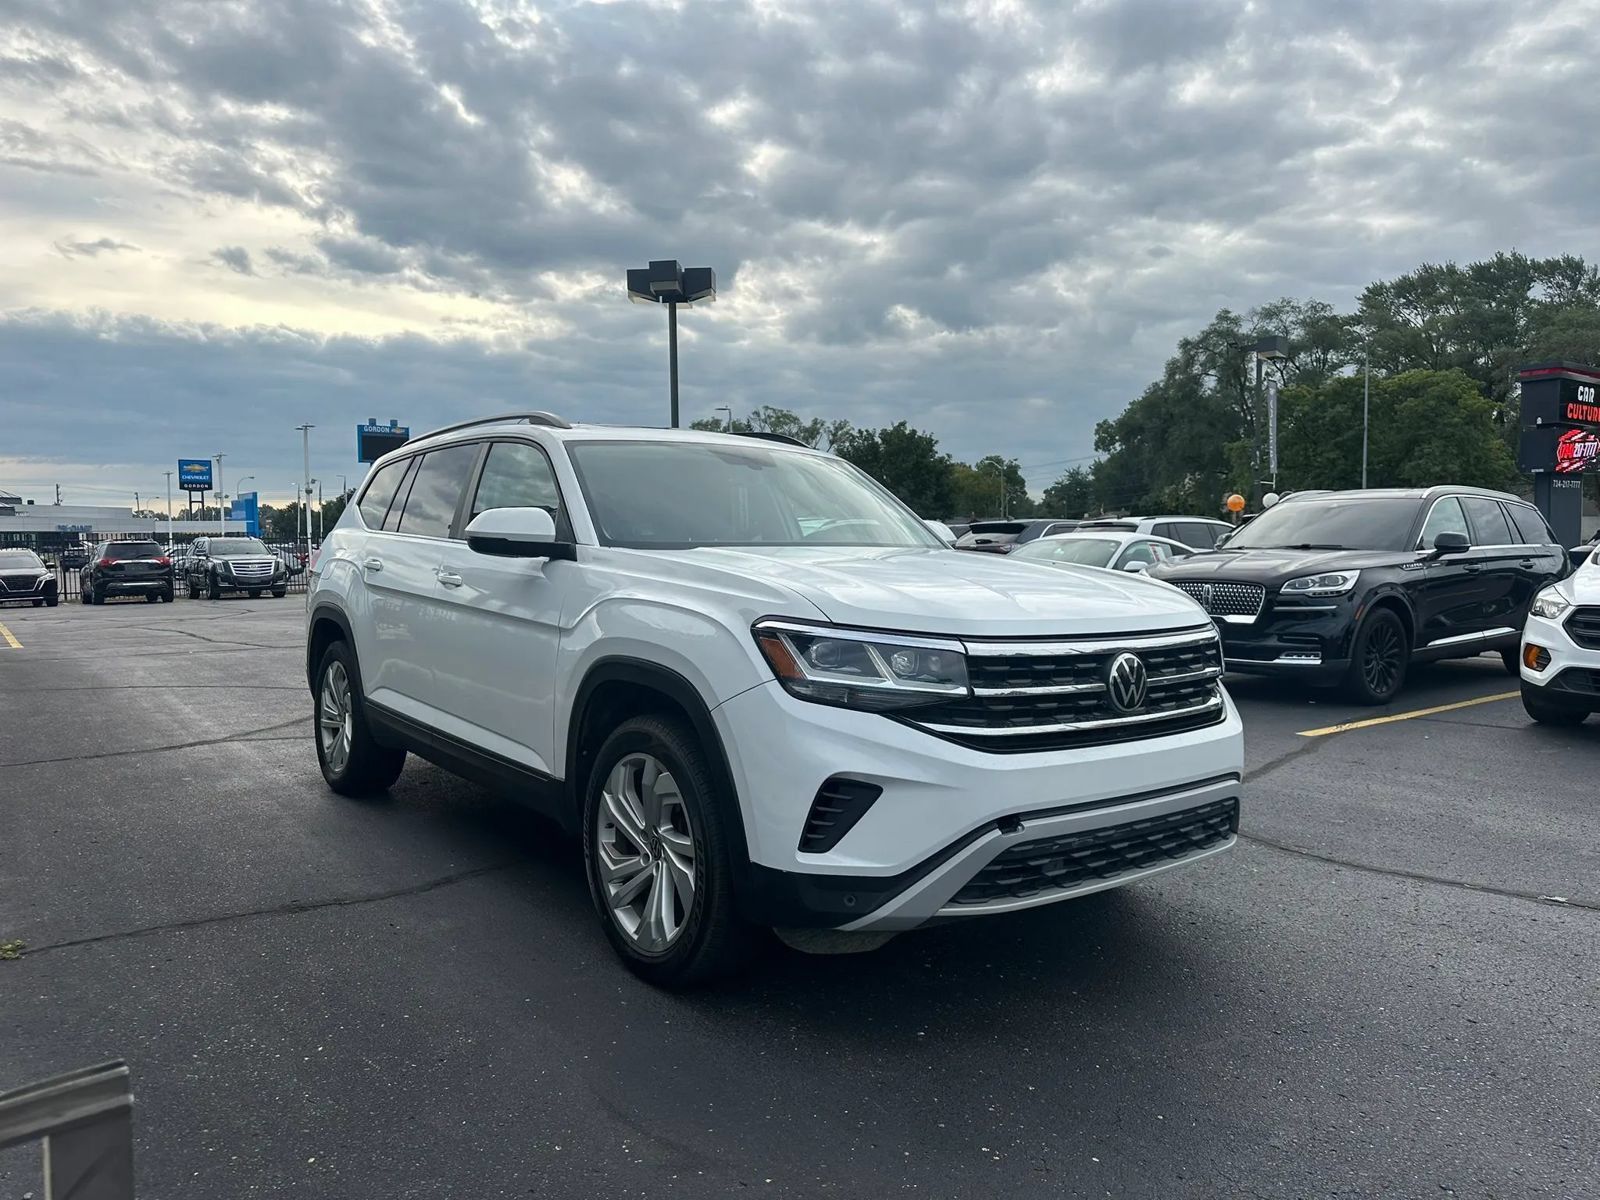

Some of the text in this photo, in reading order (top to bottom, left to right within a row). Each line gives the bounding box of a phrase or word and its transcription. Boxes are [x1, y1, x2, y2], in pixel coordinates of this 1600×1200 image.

[1577, 385, 1595, 403] CAR
[363, 425, 390, 433] GORDON
[1110, 653, 1147, 711] VW
